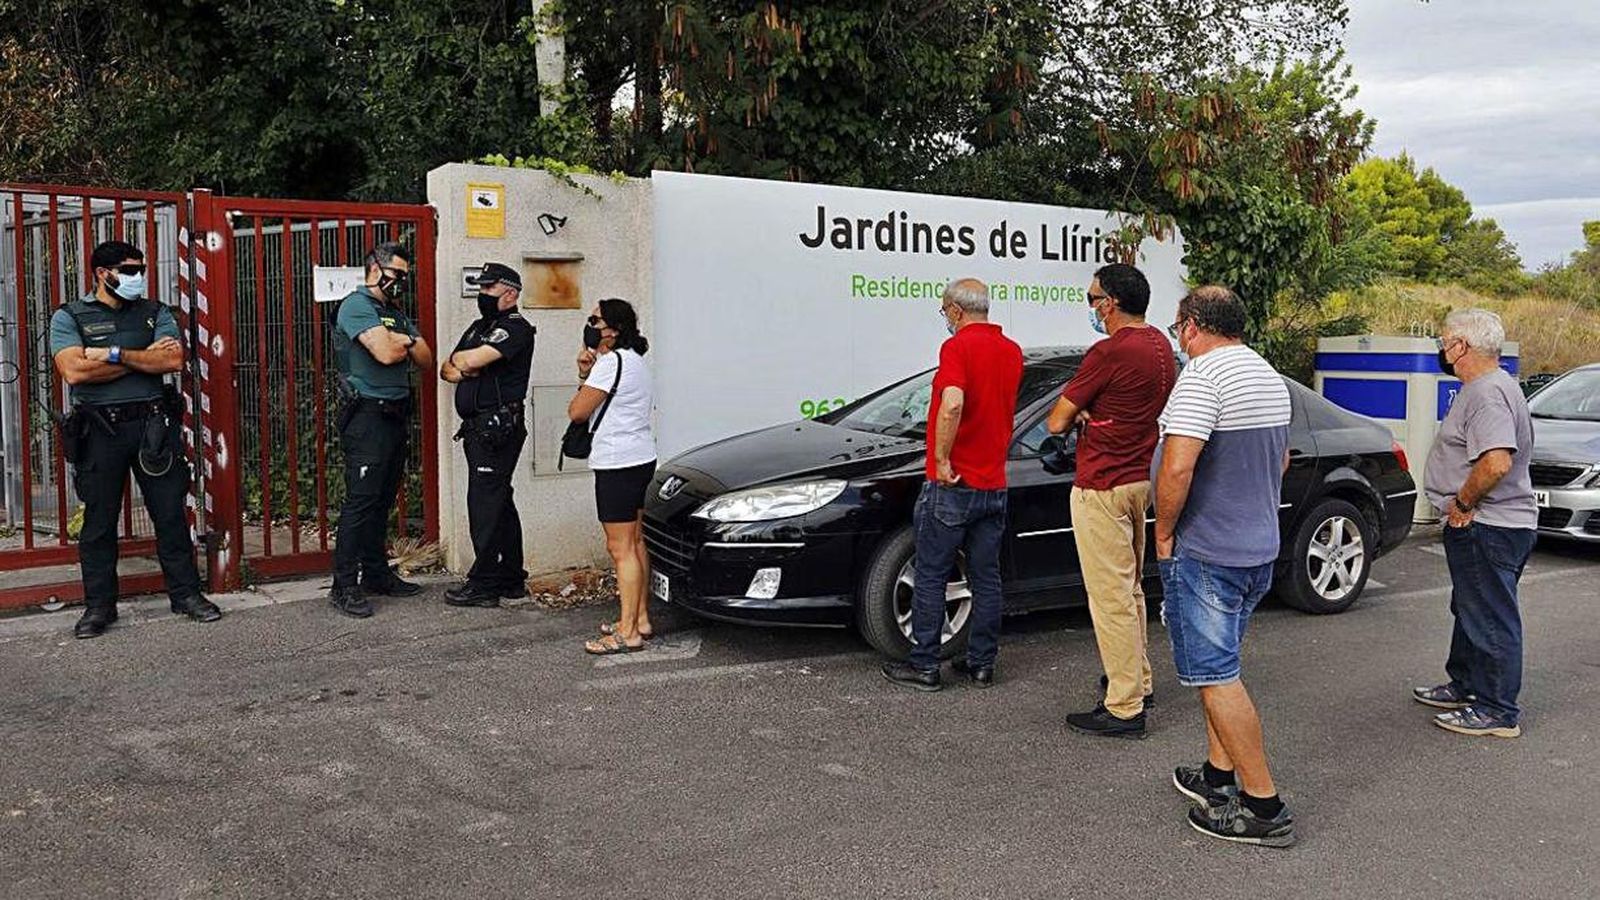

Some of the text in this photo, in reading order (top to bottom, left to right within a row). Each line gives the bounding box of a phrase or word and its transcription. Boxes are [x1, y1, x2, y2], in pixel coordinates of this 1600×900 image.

[799, 205, 1117, 264] Jardines de Llíria
[852, 274, 951, 299] Residenc
[1014, 283, 1085, 306] mayores
